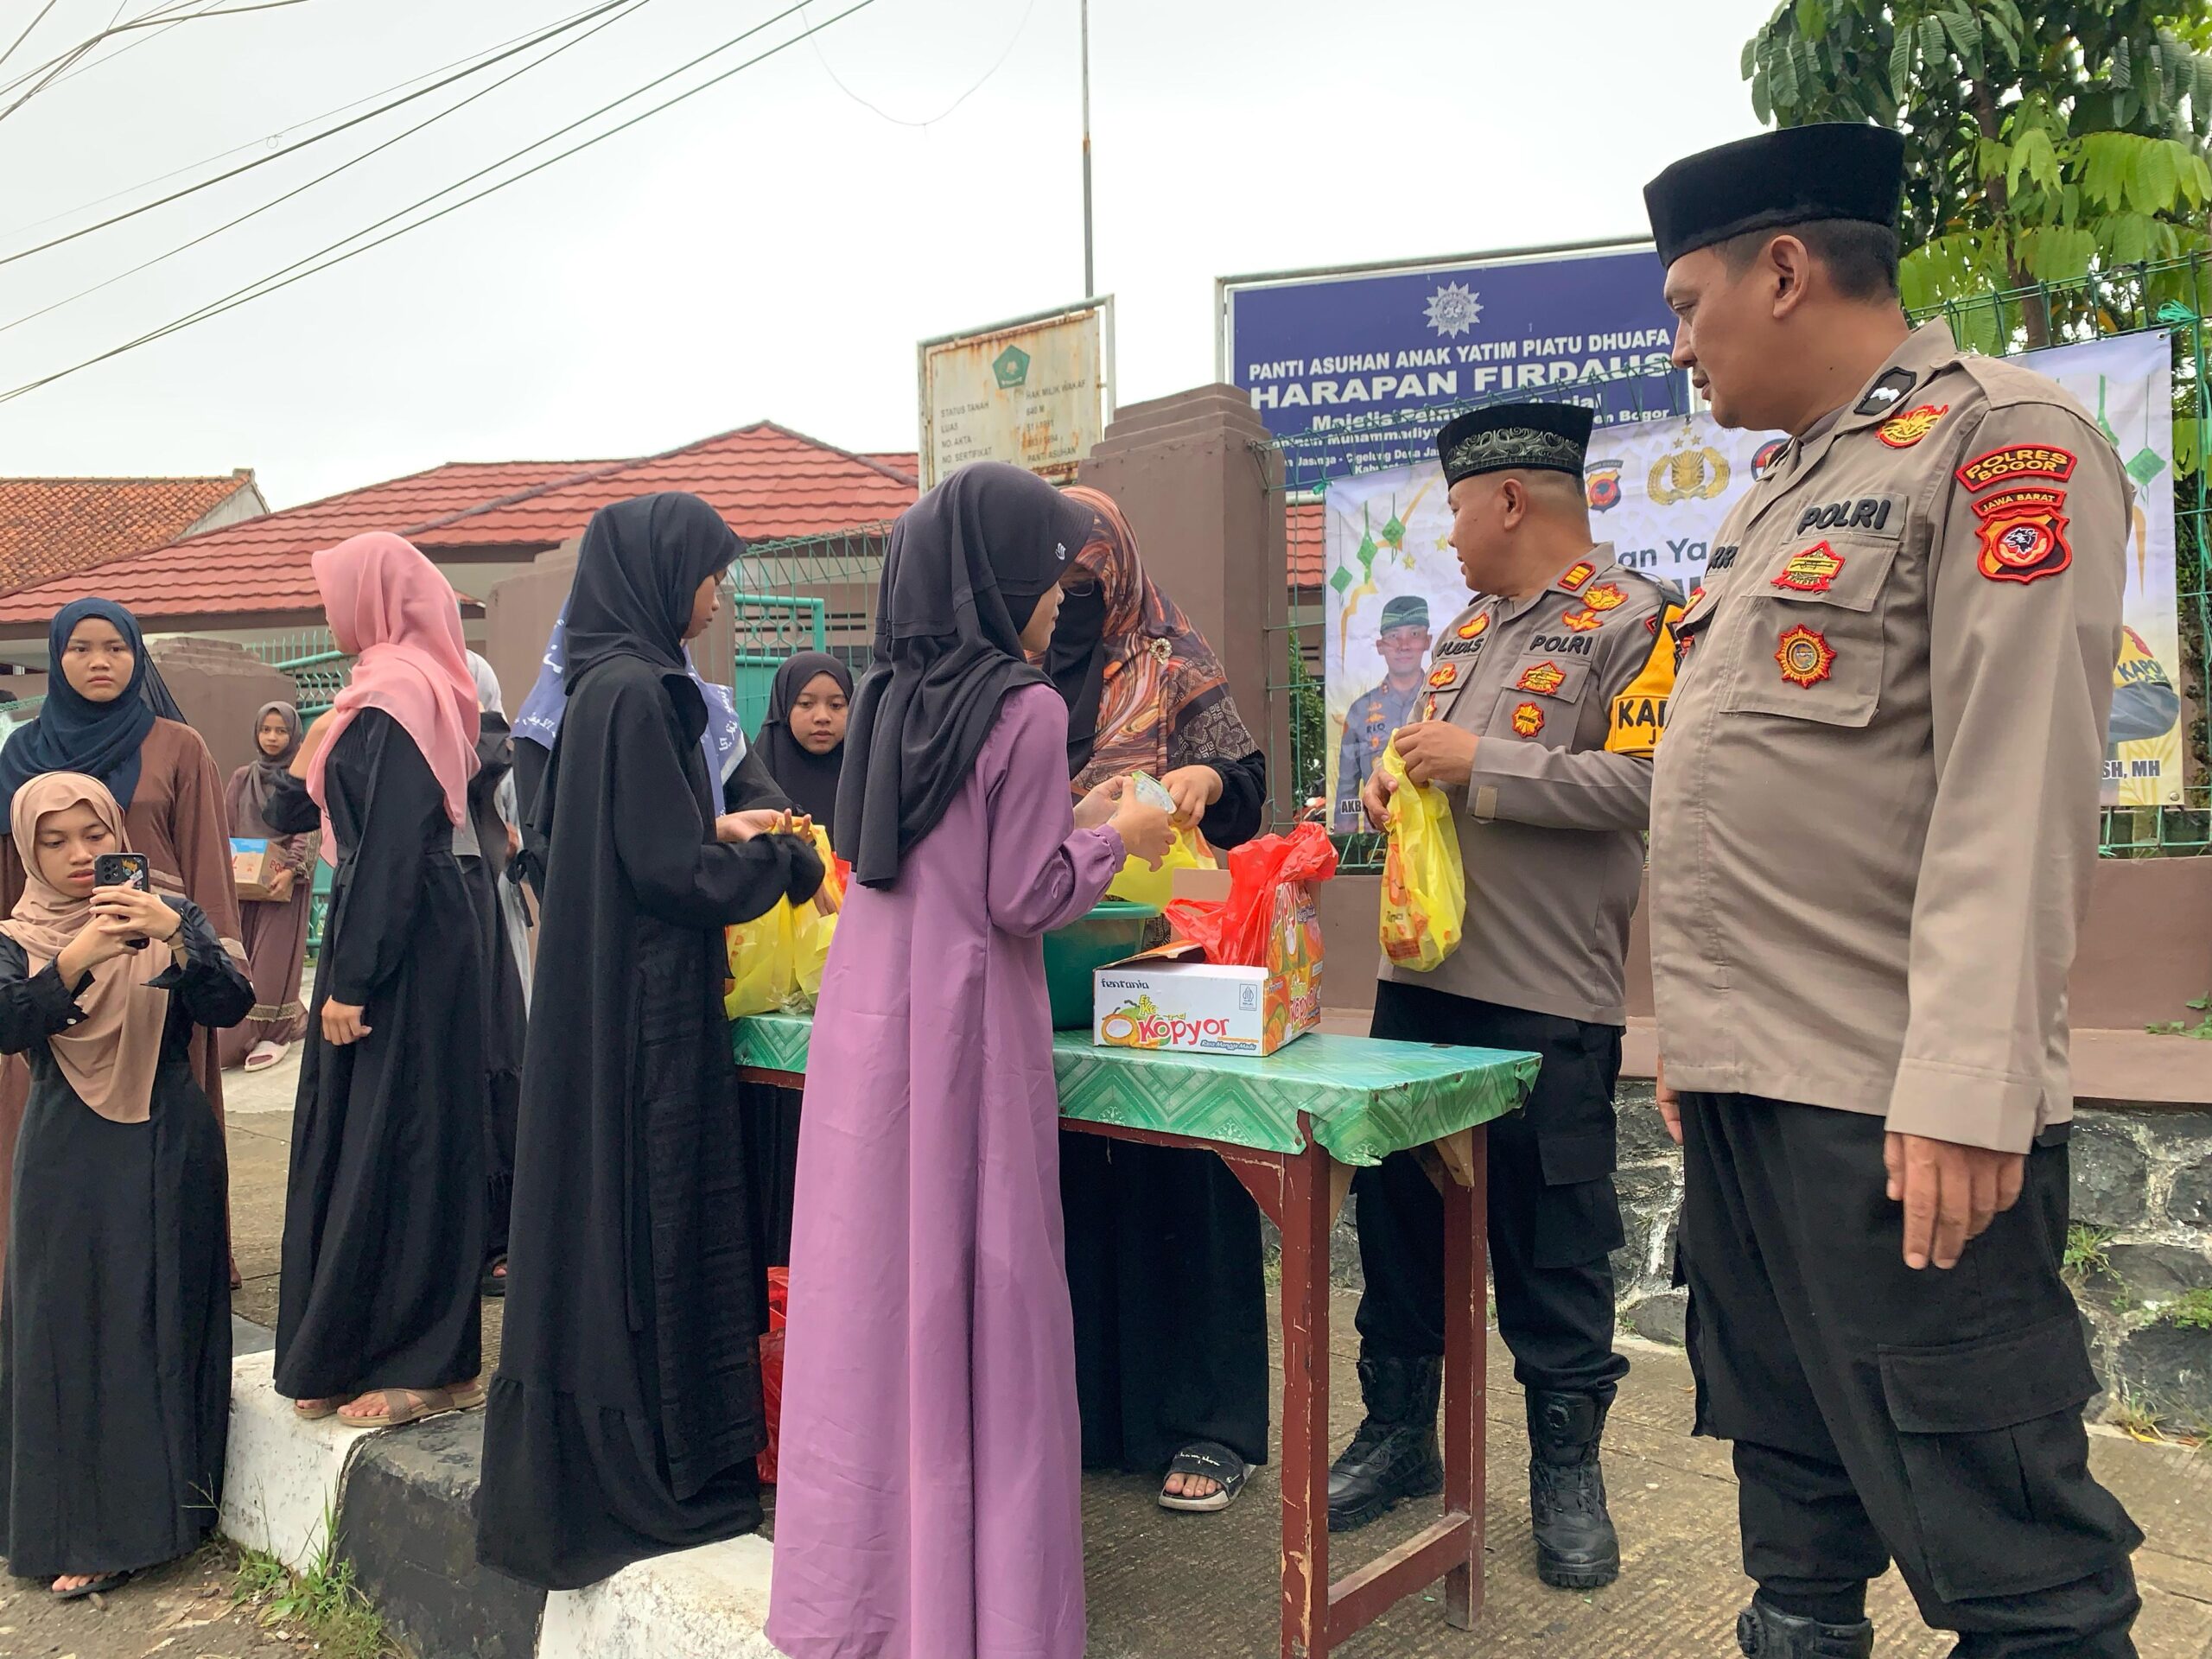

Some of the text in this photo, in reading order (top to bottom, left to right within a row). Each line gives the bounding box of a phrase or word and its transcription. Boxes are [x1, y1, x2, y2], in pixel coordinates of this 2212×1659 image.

[1249, 328, 1671, 381] PANTI ASUHAN ANAK YATIM PIATU DHUAFA
[1250, 353, 1674, 410] HARAPAN FIRDAUS
[1312, 410, 1393, 433] Majelis
[1327, 425, 1445, 445] Muhammadiya
[1619, 409, 1670, 423] Bogor
[1424, 446, 1440, 457] Jas
[1965, 449, 2068, 480] POLRES
[1978, 460, 2057, 481] BOGOR
[1982, 493, 2056, 512] JAWA BARAT
[1796, 499, 1891, 536] POLRI
[1618, 537, 1707, 569] an Ya
[1529, 634, 1593, 656] POLRI
[2132, 760, 2160, 777] MH
[1342, 800, 1363, 813] AKB
[1137, 1014, 1230, 1046] Kopyor
